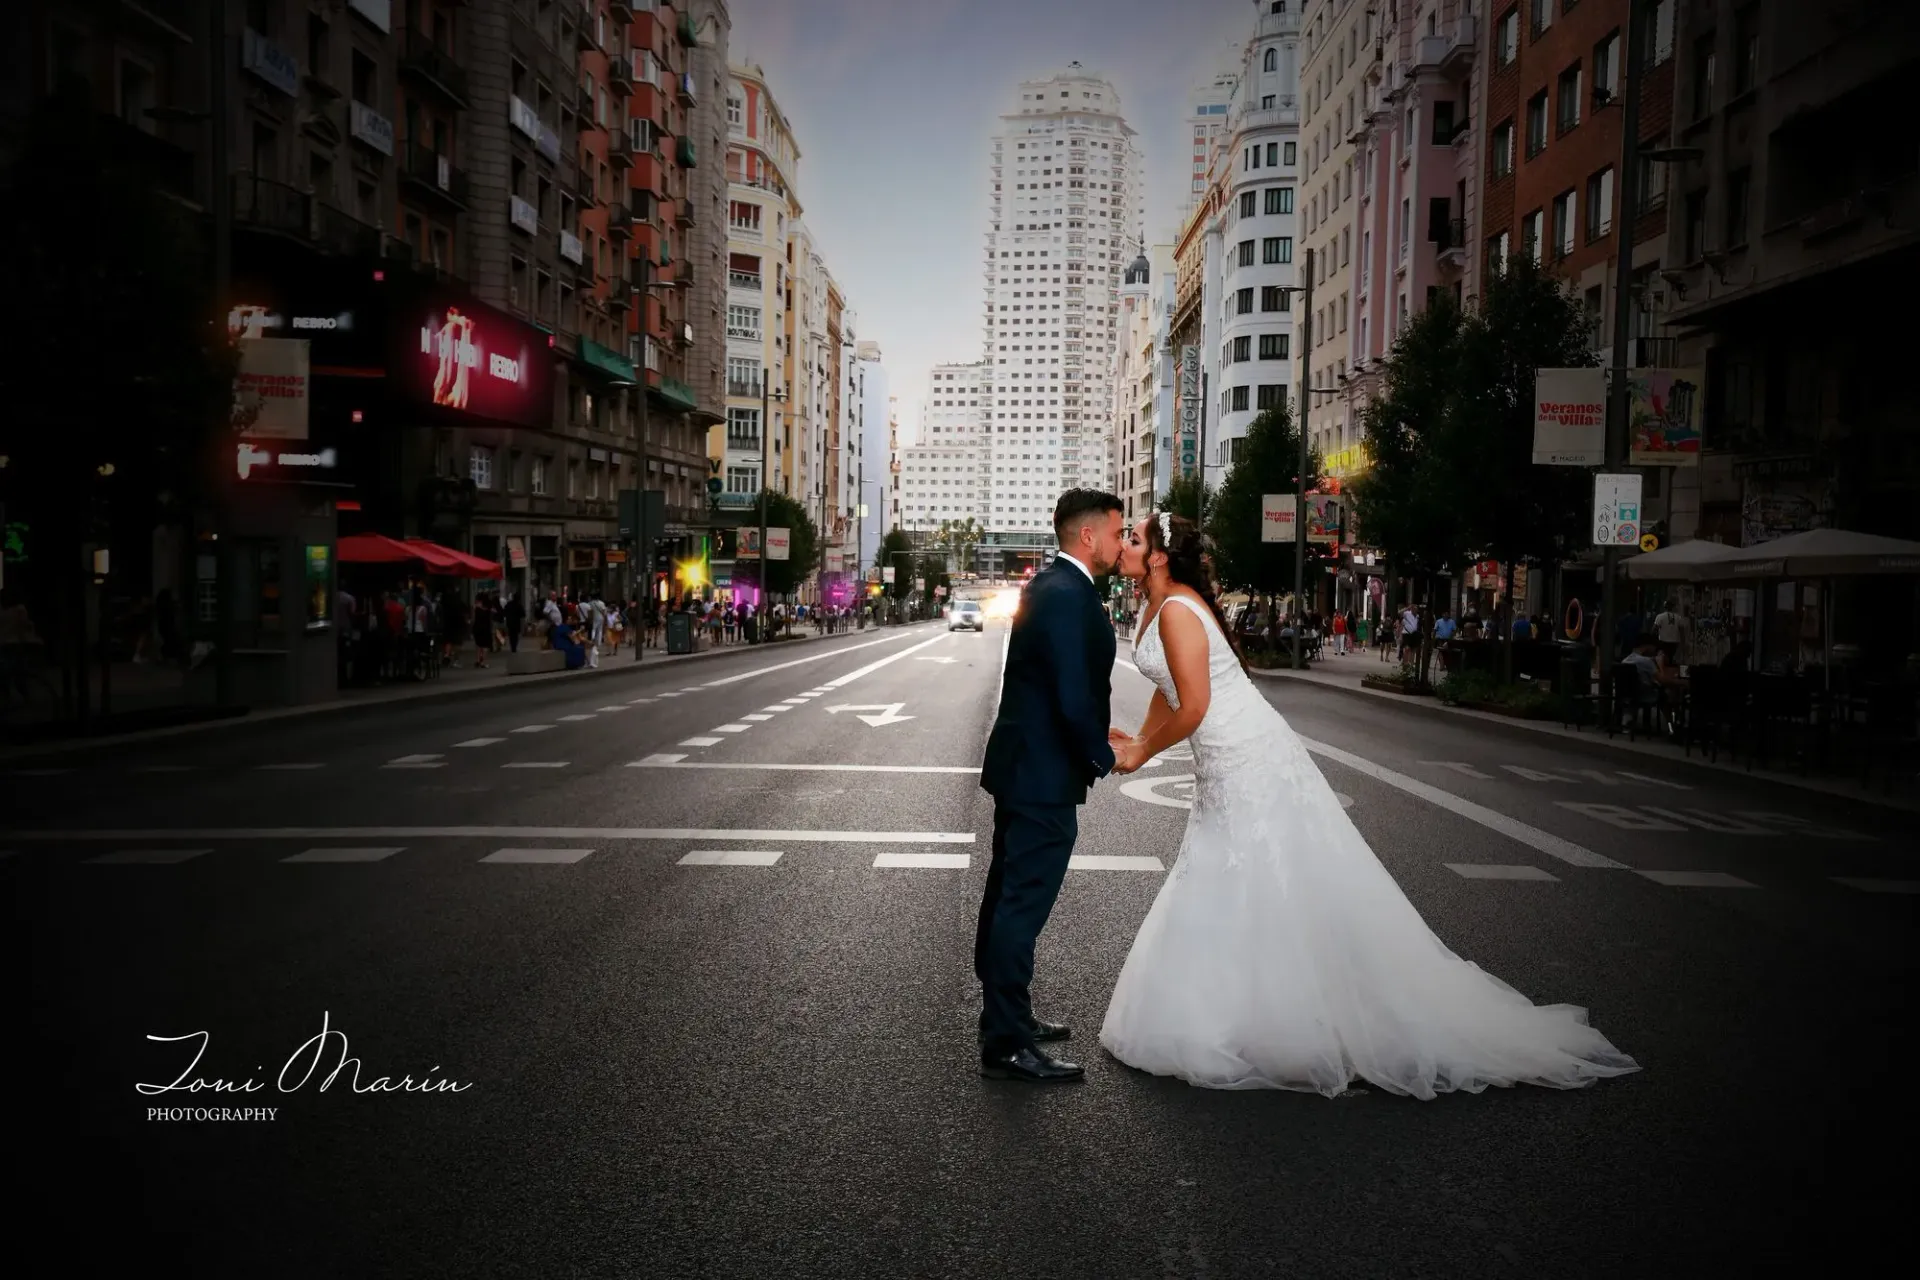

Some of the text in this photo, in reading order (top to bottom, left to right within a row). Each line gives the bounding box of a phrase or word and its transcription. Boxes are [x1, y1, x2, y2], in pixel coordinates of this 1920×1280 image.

[727, 327, 756, 339] BOUTIQUE
[489, 352, 519, 383] REBRO
[1182, 347, 1198, 434] SENATOR
[1540, 403, 1602, 414] Veranos
